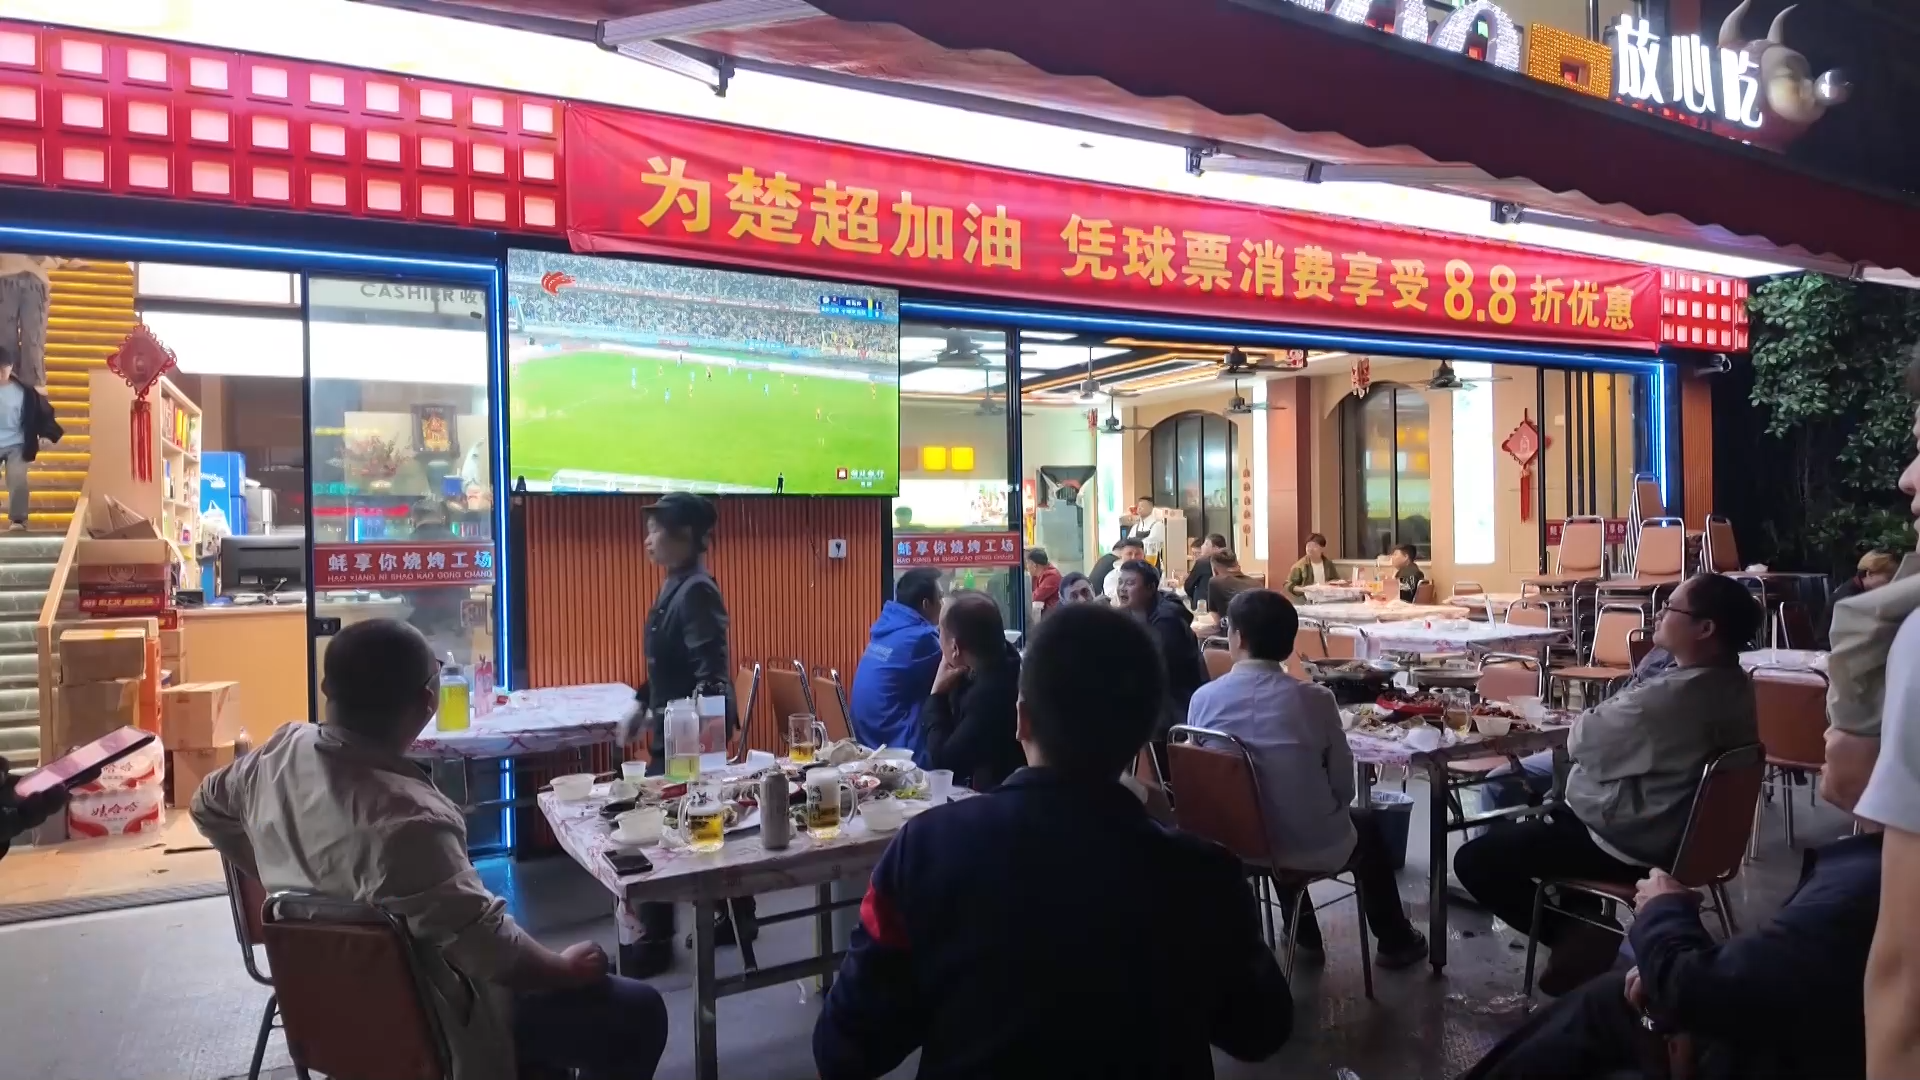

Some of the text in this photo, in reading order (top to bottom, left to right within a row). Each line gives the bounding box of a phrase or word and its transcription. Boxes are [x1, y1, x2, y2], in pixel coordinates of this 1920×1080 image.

[1614, 13, 1763, 128] 放心吃
[638, 156, 1636, 331] 为楚超加油 凭球票消费享受8.8折优惠
[360, 282, 455, 303] CASHIER
[897, 538, 1014, 555] 蚝享你烧烤工场
[328, 551, 492, 572] 蚝享你烧烤工场
[327, 574, 347, 583] HAO
[350, 573, 376, 583] XIANG
[378, 573, 388, 582] NI
[391, 573, 414, 581] SHAO
[416, 571, 434, 580] KAO
[437, 570, 461, 580] GONG
